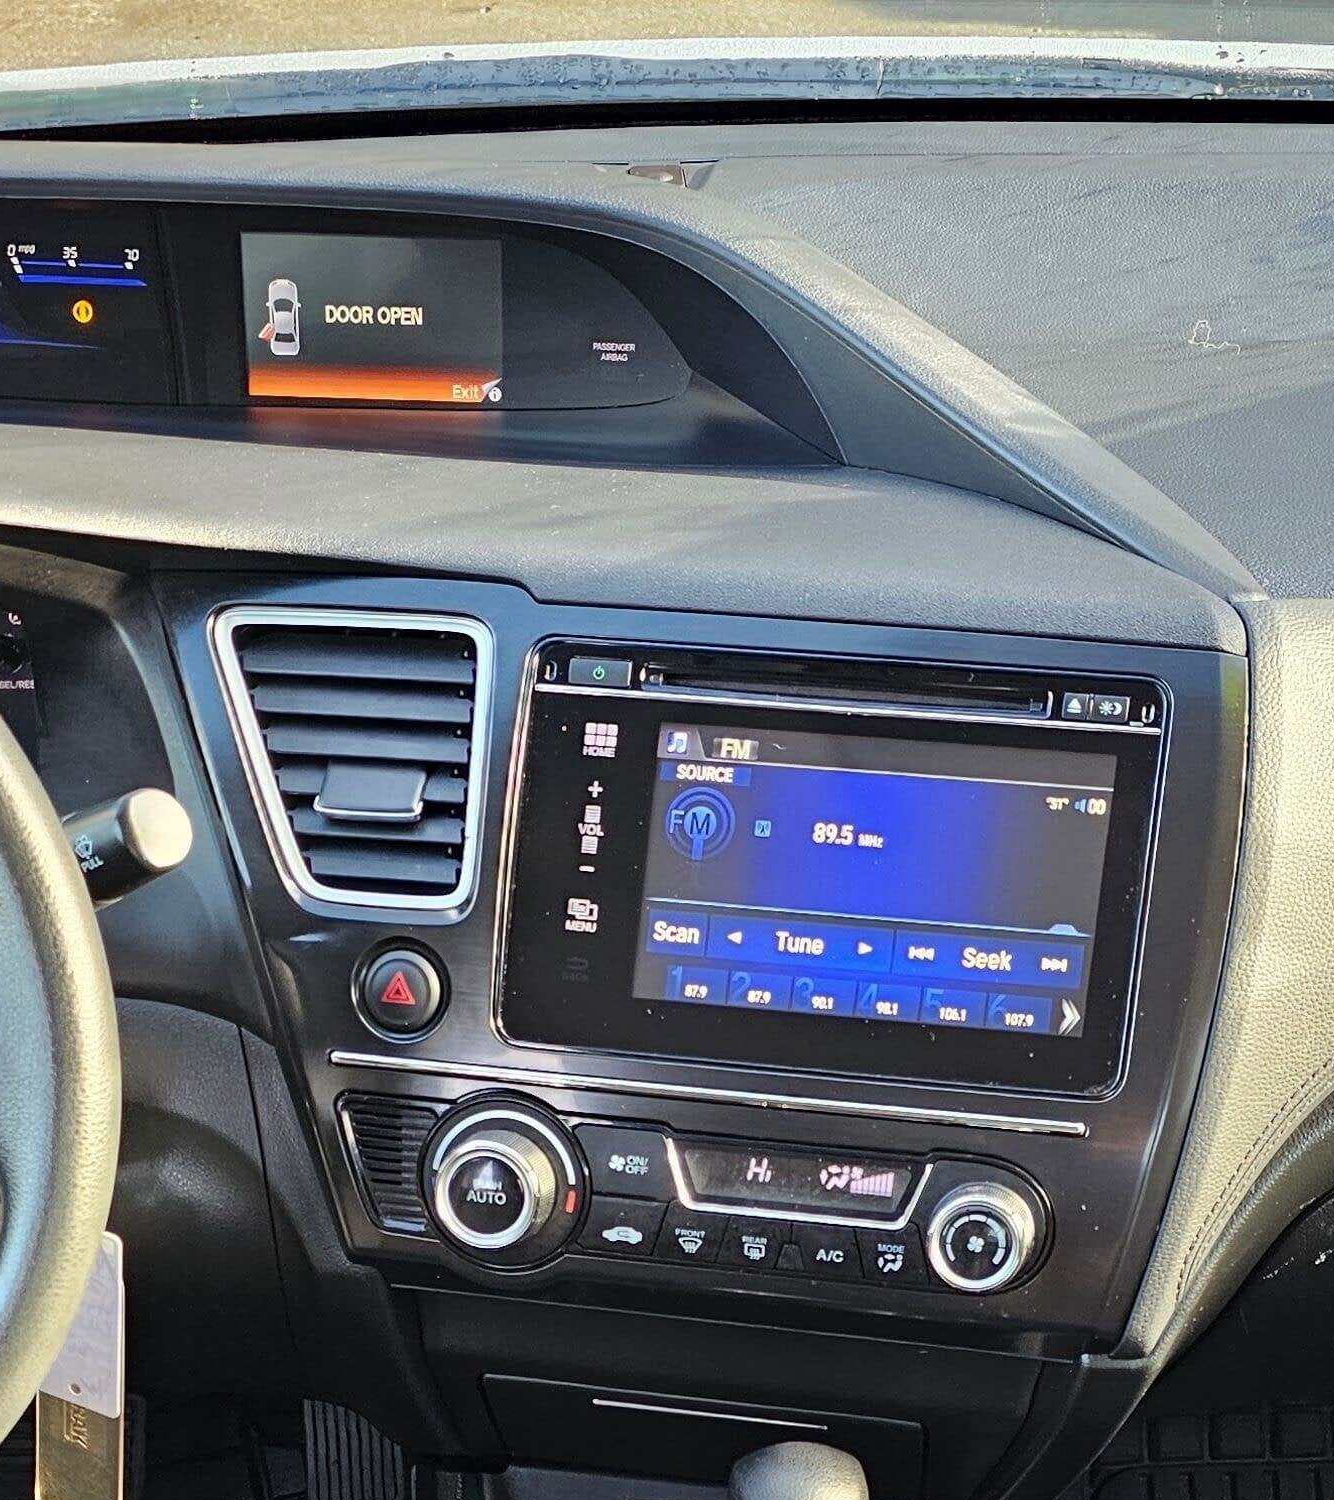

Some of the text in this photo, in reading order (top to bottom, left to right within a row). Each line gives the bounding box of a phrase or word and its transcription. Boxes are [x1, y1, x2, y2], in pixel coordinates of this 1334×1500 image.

[7, 244, 17, 257] 0
[62, 246, 78, 259] 35
[124, 249, 140, 262] 70
[324, 304, 423, 326] DOOR OPEN
[592, 342, 636, 352] PASSENGER
[600, 352, 629, 362] AIRBAG
[452, 384, 480, 400] Exit
[582, 746, 616, 758] HOME
[719, 738, 752, 760] FM
[676, 764, 735, 784] SOURCE
[578, 822, 605, 837] VOL
[669, 810, 710, 836] FM
[812, 822, 884, 849] 89.5 MHz
[80, 854, 104, 874] PULL
[565, 918, 598, 934] MENU
[652, 920, 701, 945] Scan
[775, 930, 826, 956] Tune
[961, 946, 1013, 973] Seek
[683, 983, 709, 1000] 87.9
[747, 988, 773, 1005] 87.9
[626, 1154, 649, 1165] ON/
[625, 1165, 649, 1176] OFF
[466, 1189, 507, 1206] AUTO
[675, 1227, 706, 1238] FRONT
[741, 1235, 768, 1245] REAR
[877, 1243, 905, 1254] MODE
[816, 1250, 845, 1264] A/C
